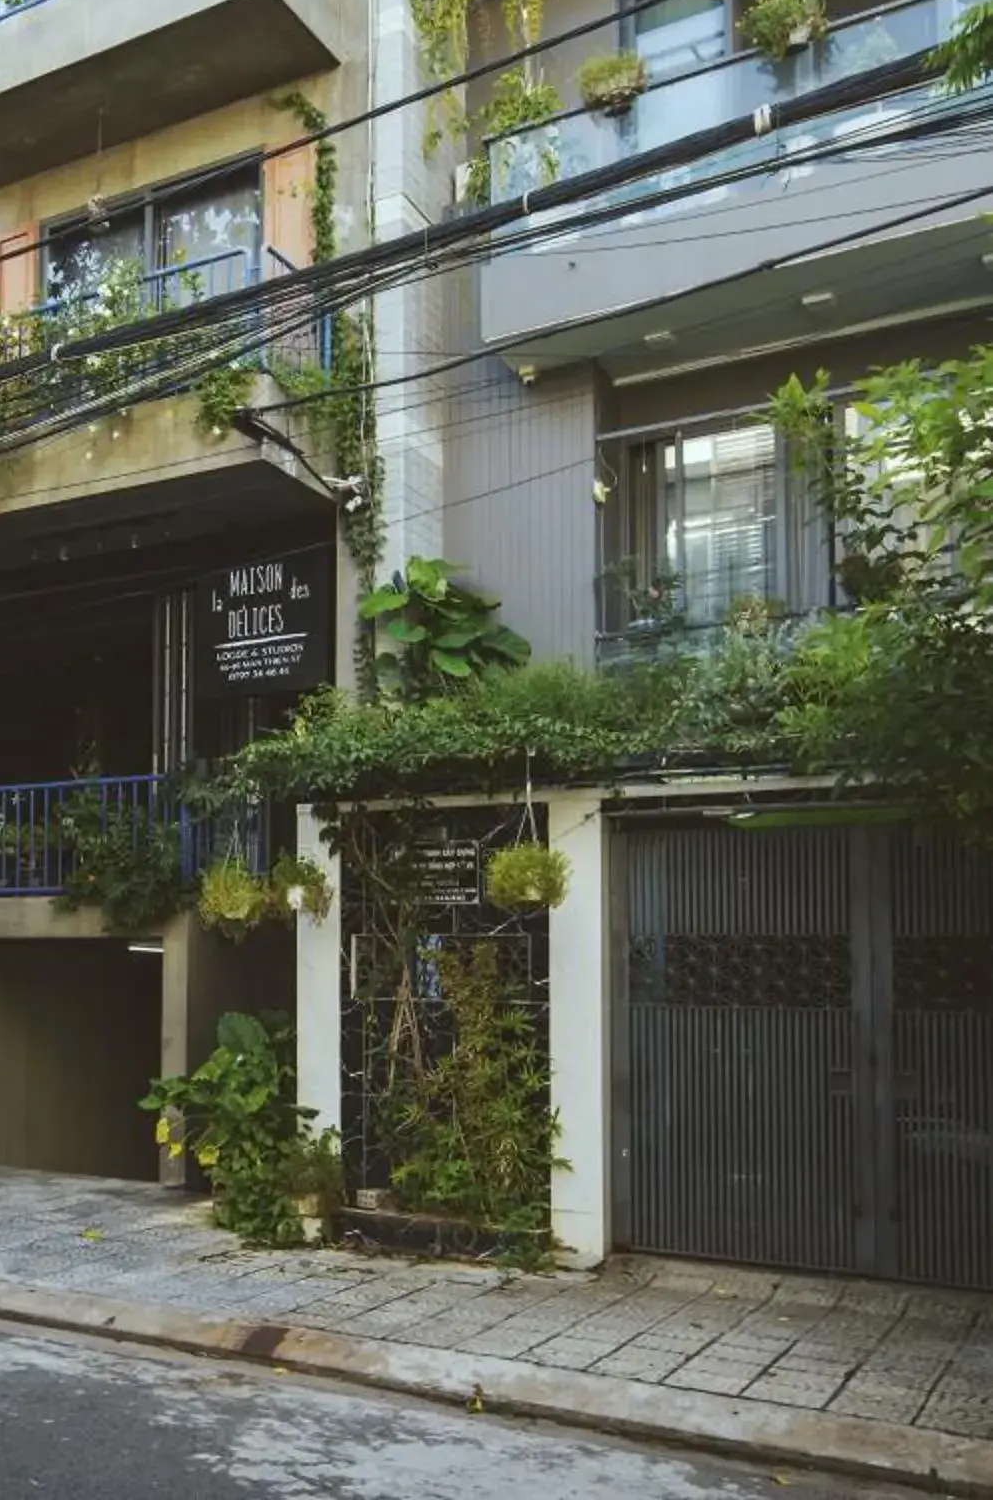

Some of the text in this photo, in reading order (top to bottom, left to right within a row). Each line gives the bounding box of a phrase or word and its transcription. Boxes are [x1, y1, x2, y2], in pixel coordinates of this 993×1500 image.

[212, 563, 310, 612] la MAISON des
